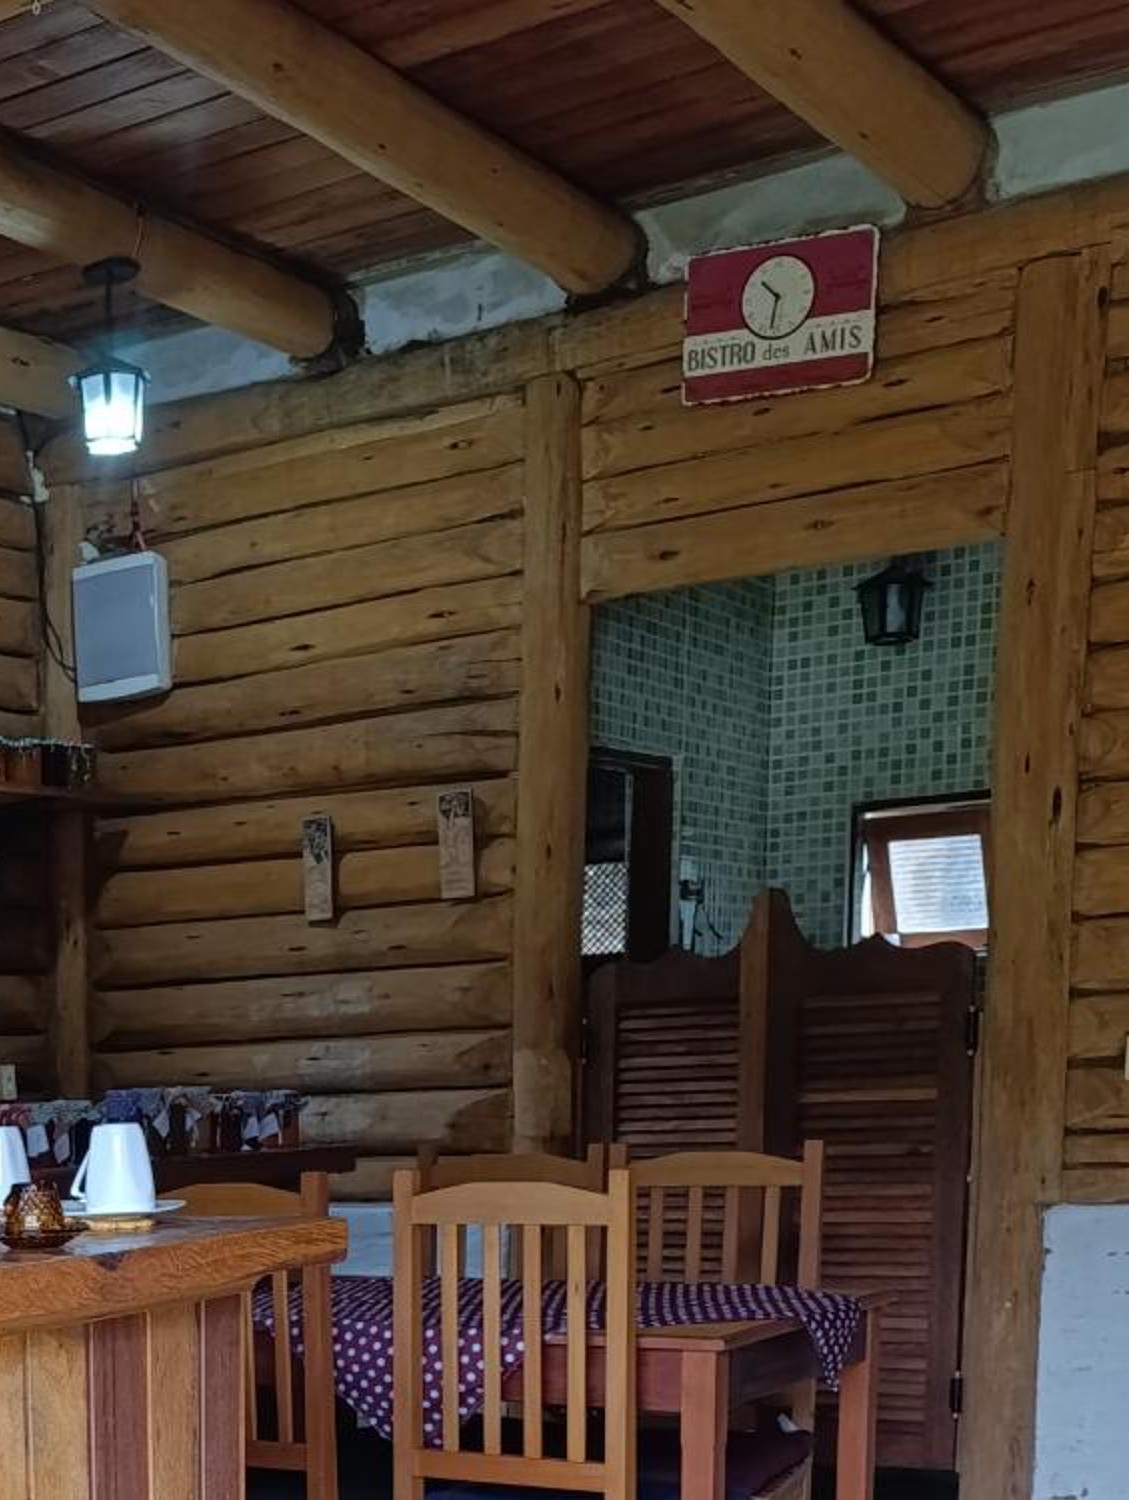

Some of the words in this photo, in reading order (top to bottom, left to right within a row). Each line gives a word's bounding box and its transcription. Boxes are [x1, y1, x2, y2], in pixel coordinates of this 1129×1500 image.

[688, 341, 756, 372] BISTRO
[763, 343, 790, 361] des
[804, 324, 862, 355] AMIS
